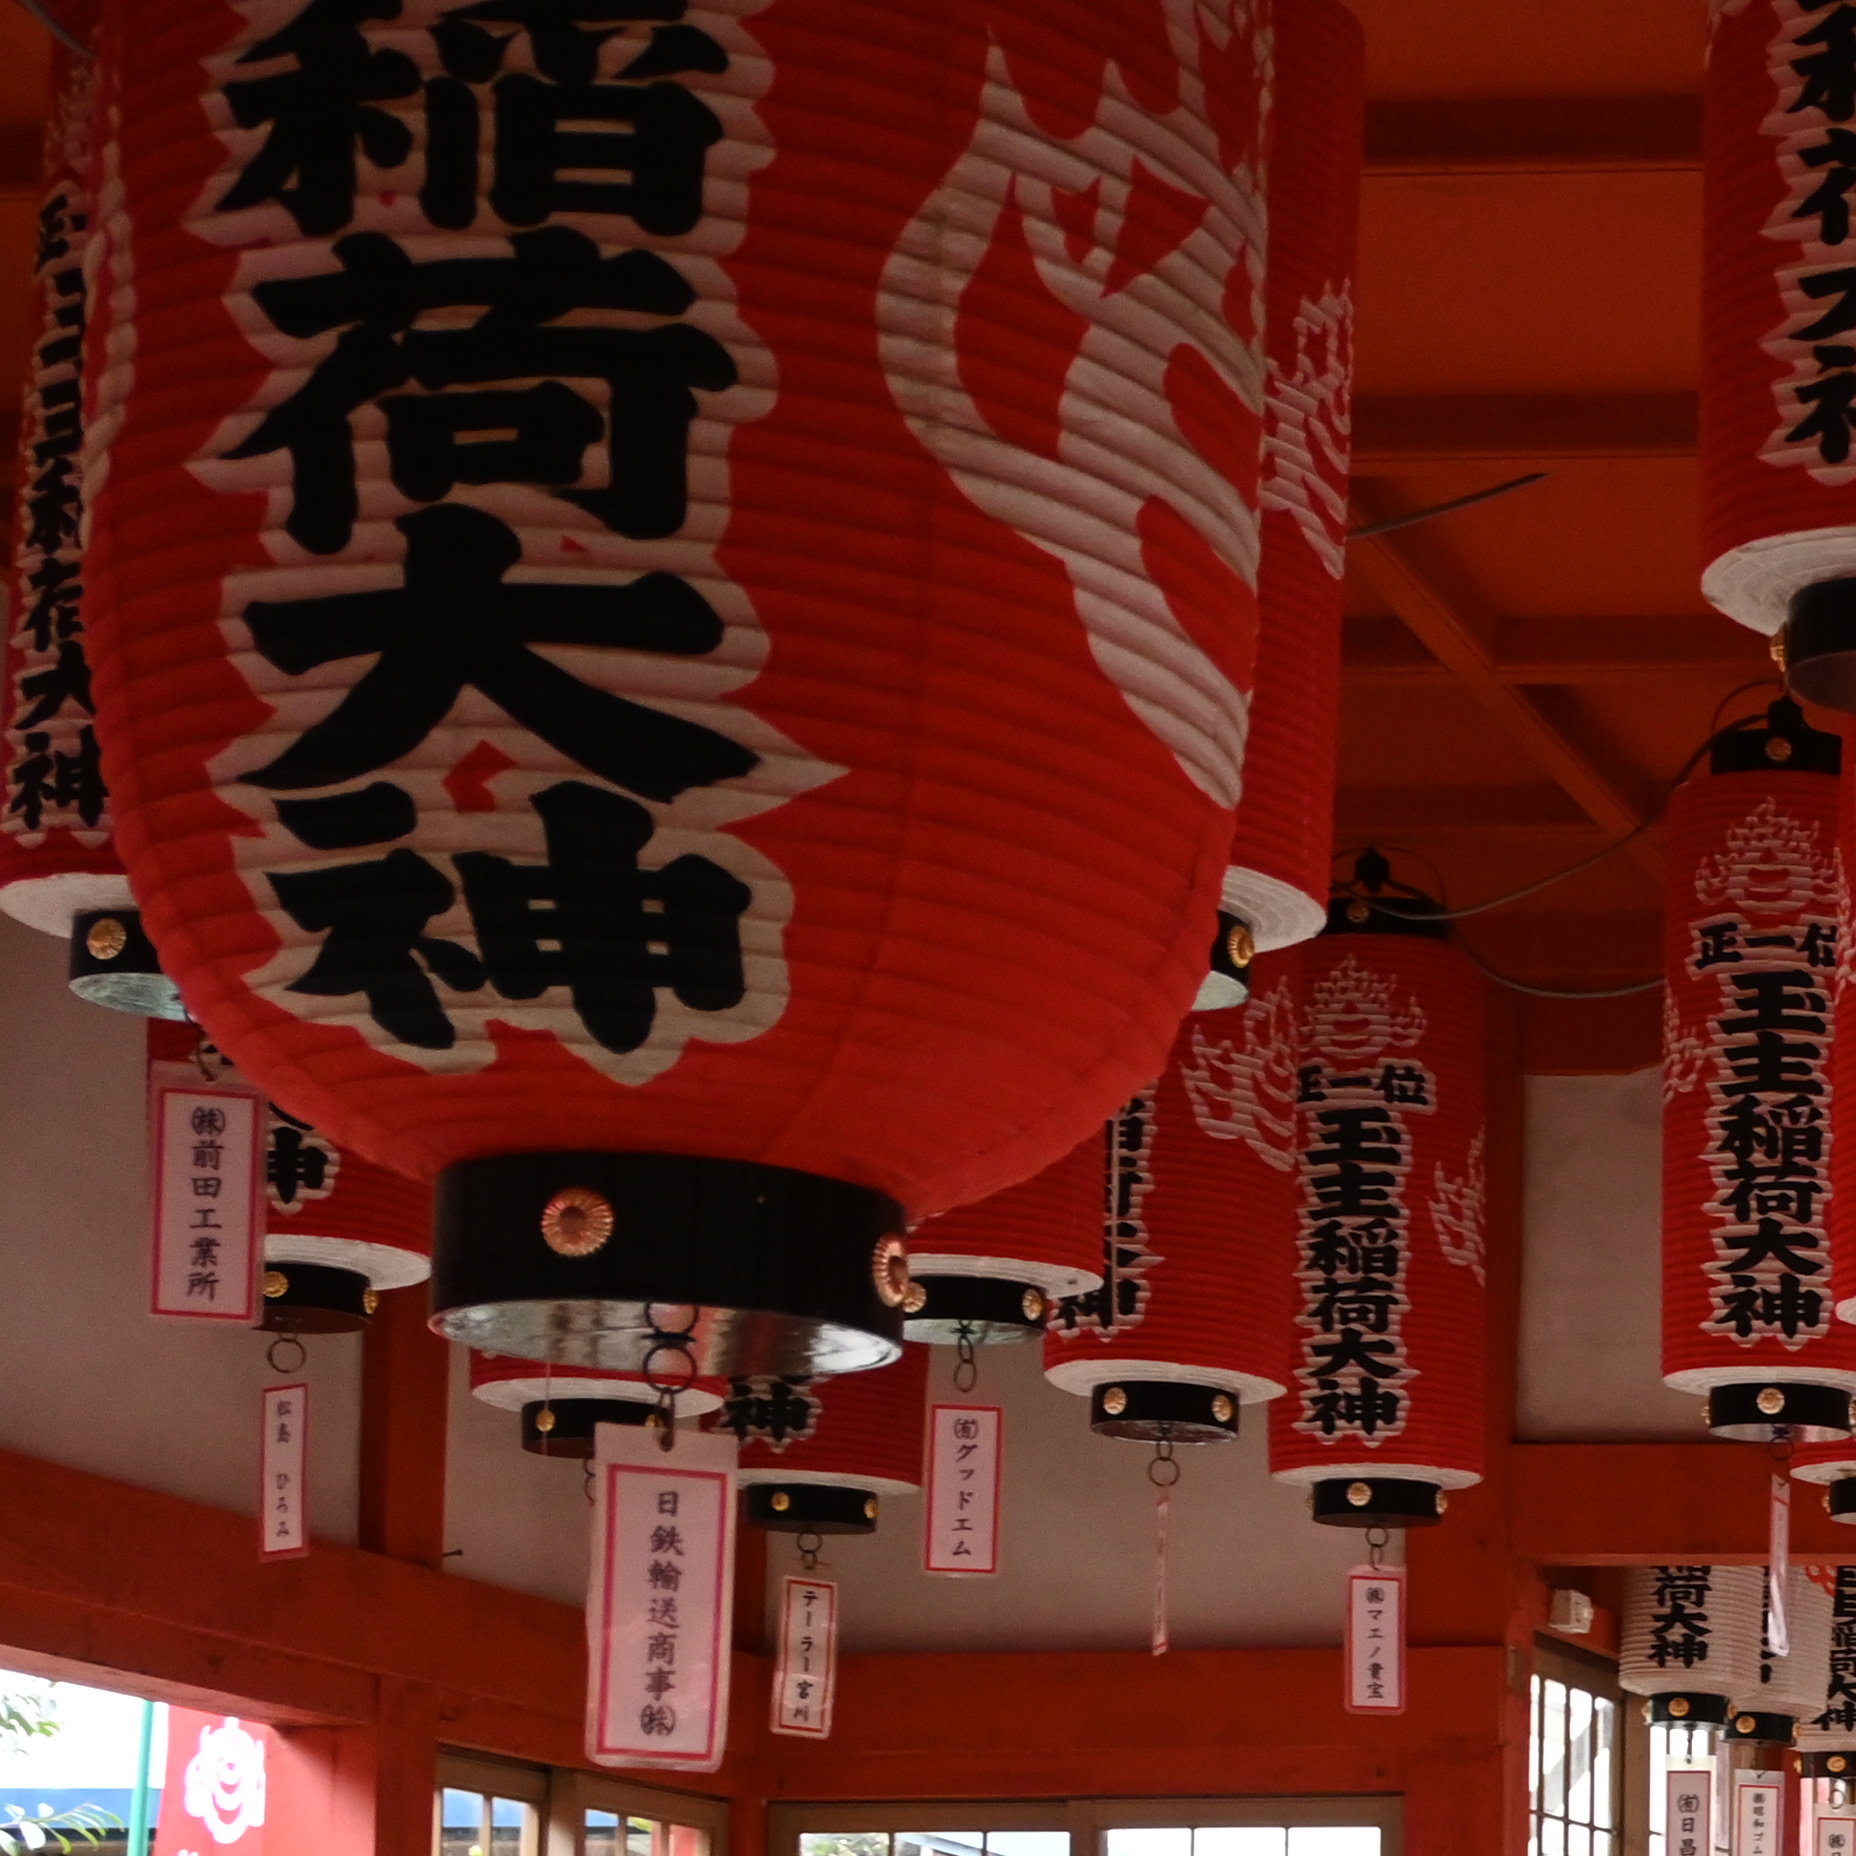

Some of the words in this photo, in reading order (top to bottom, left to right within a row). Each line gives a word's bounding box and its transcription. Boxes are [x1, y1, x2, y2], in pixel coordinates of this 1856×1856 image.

[1308, 1109, 1402, 1434] 玉主稲荷大神
[1721, 971, 1827, 1338] 玉主稲荷大神
